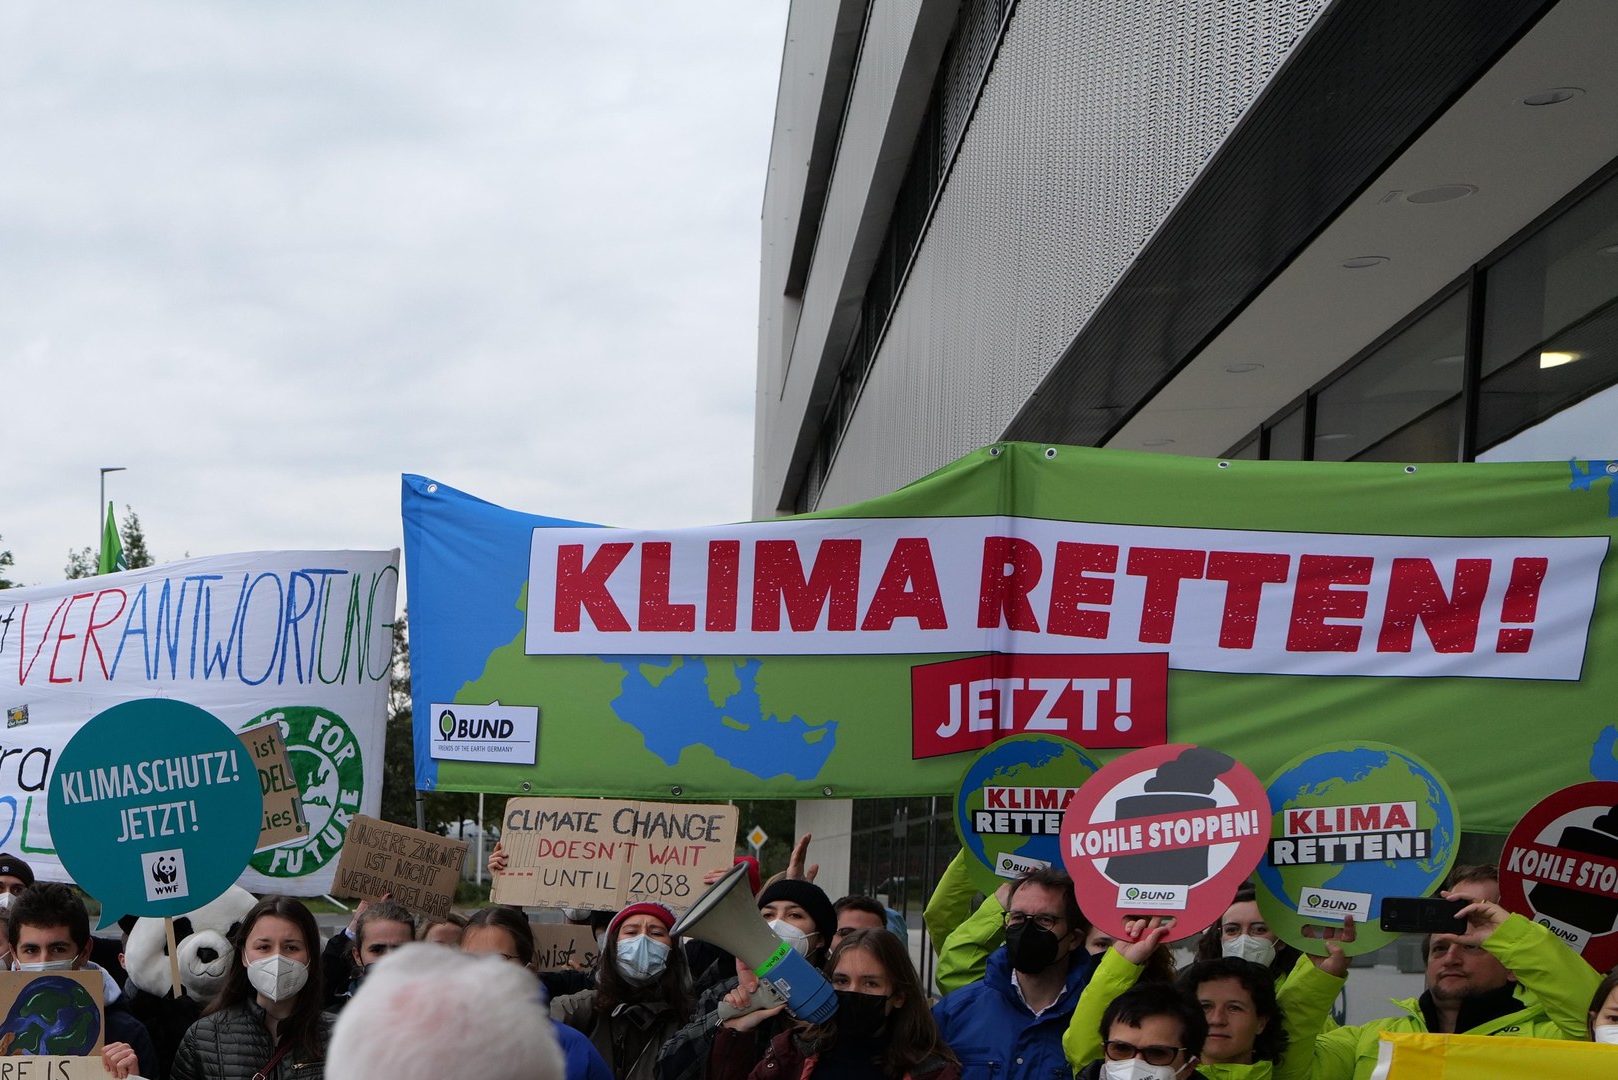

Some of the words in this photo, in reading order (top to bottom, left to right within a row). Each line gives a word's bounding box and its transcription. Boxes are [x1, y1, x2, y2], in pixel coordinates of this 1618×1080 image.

[552, 536, 949, 634] KLIMA
[977, 534, 1550, 655] RETTEN!
[18, 565, 398, 688] VERANTWORTUNG
[935, 677, 1135, 739] JETZT!
[253, 735, 275, 758] ist
[308, 715, 356, 766] FOR
[457, 719, 514, 739] BUND
[61, 749, 240, 805] KLIMASCHUTZ!
[116, 800, 199, 843] JETZT!
[268, 788, 359, 874] FUTURE
[507, 809, 602, 834] CLIMATE
[613, 808, 726, 843] CHANGE
[1070, 827, 1142, 858] KOHLE
[1148, 809, 1259, 849] STOPPEN!
[1289, 803, 1411, 835] KLIMA
[349, 822, 411, 857] UNSERE
[408, 838, 468, 871] ZUKUNFT
[364, 852, 392, 872] IST
[537, 838, 639, 863] DOESN'T
[648, 843, 707, 868] WAIT
[1274, 831, 1426, 865] RETTEN!
[1507, 846, 1577, 883] KOHLE
[154, 884, 179, 895] WWF
[543, 868, 617, 890] UNTIL
[630, 871, 691, 897] 2038
[1140, 891, 1175, 900] BUND
[1321, 899, 1357, 911] BUND
